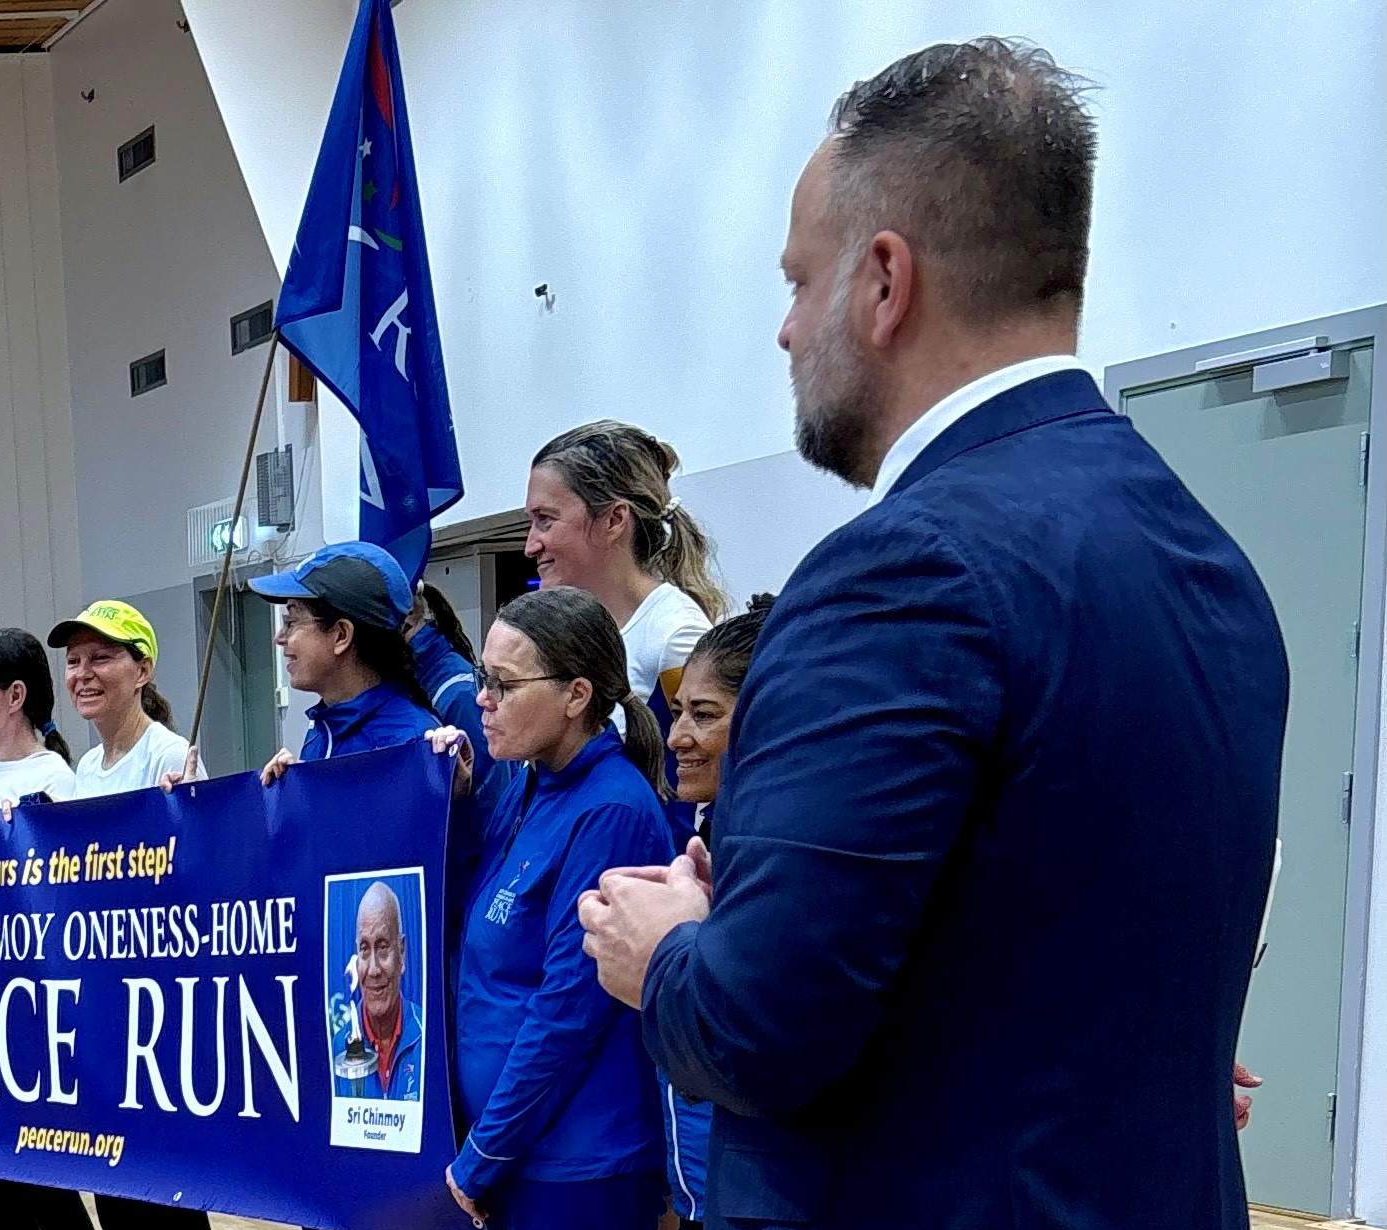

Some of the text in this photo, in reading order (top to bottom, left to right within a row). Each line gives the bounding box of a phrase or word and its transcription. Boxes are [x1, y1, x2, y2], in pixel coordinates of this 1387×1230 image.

[21, 847, 45, 886] is
[48, 846, 81, 885] the
[84, 841, 125, 882] first
[127, 836, 177, 880] step!
[63, 896, 298, 961] ONENESS-HOME
[118, 973, 301, 1123] RUN
[347, 1105, 406, 1132] Sri Chinmoy
[14, 1125, 125, 1168] peacerun.org
